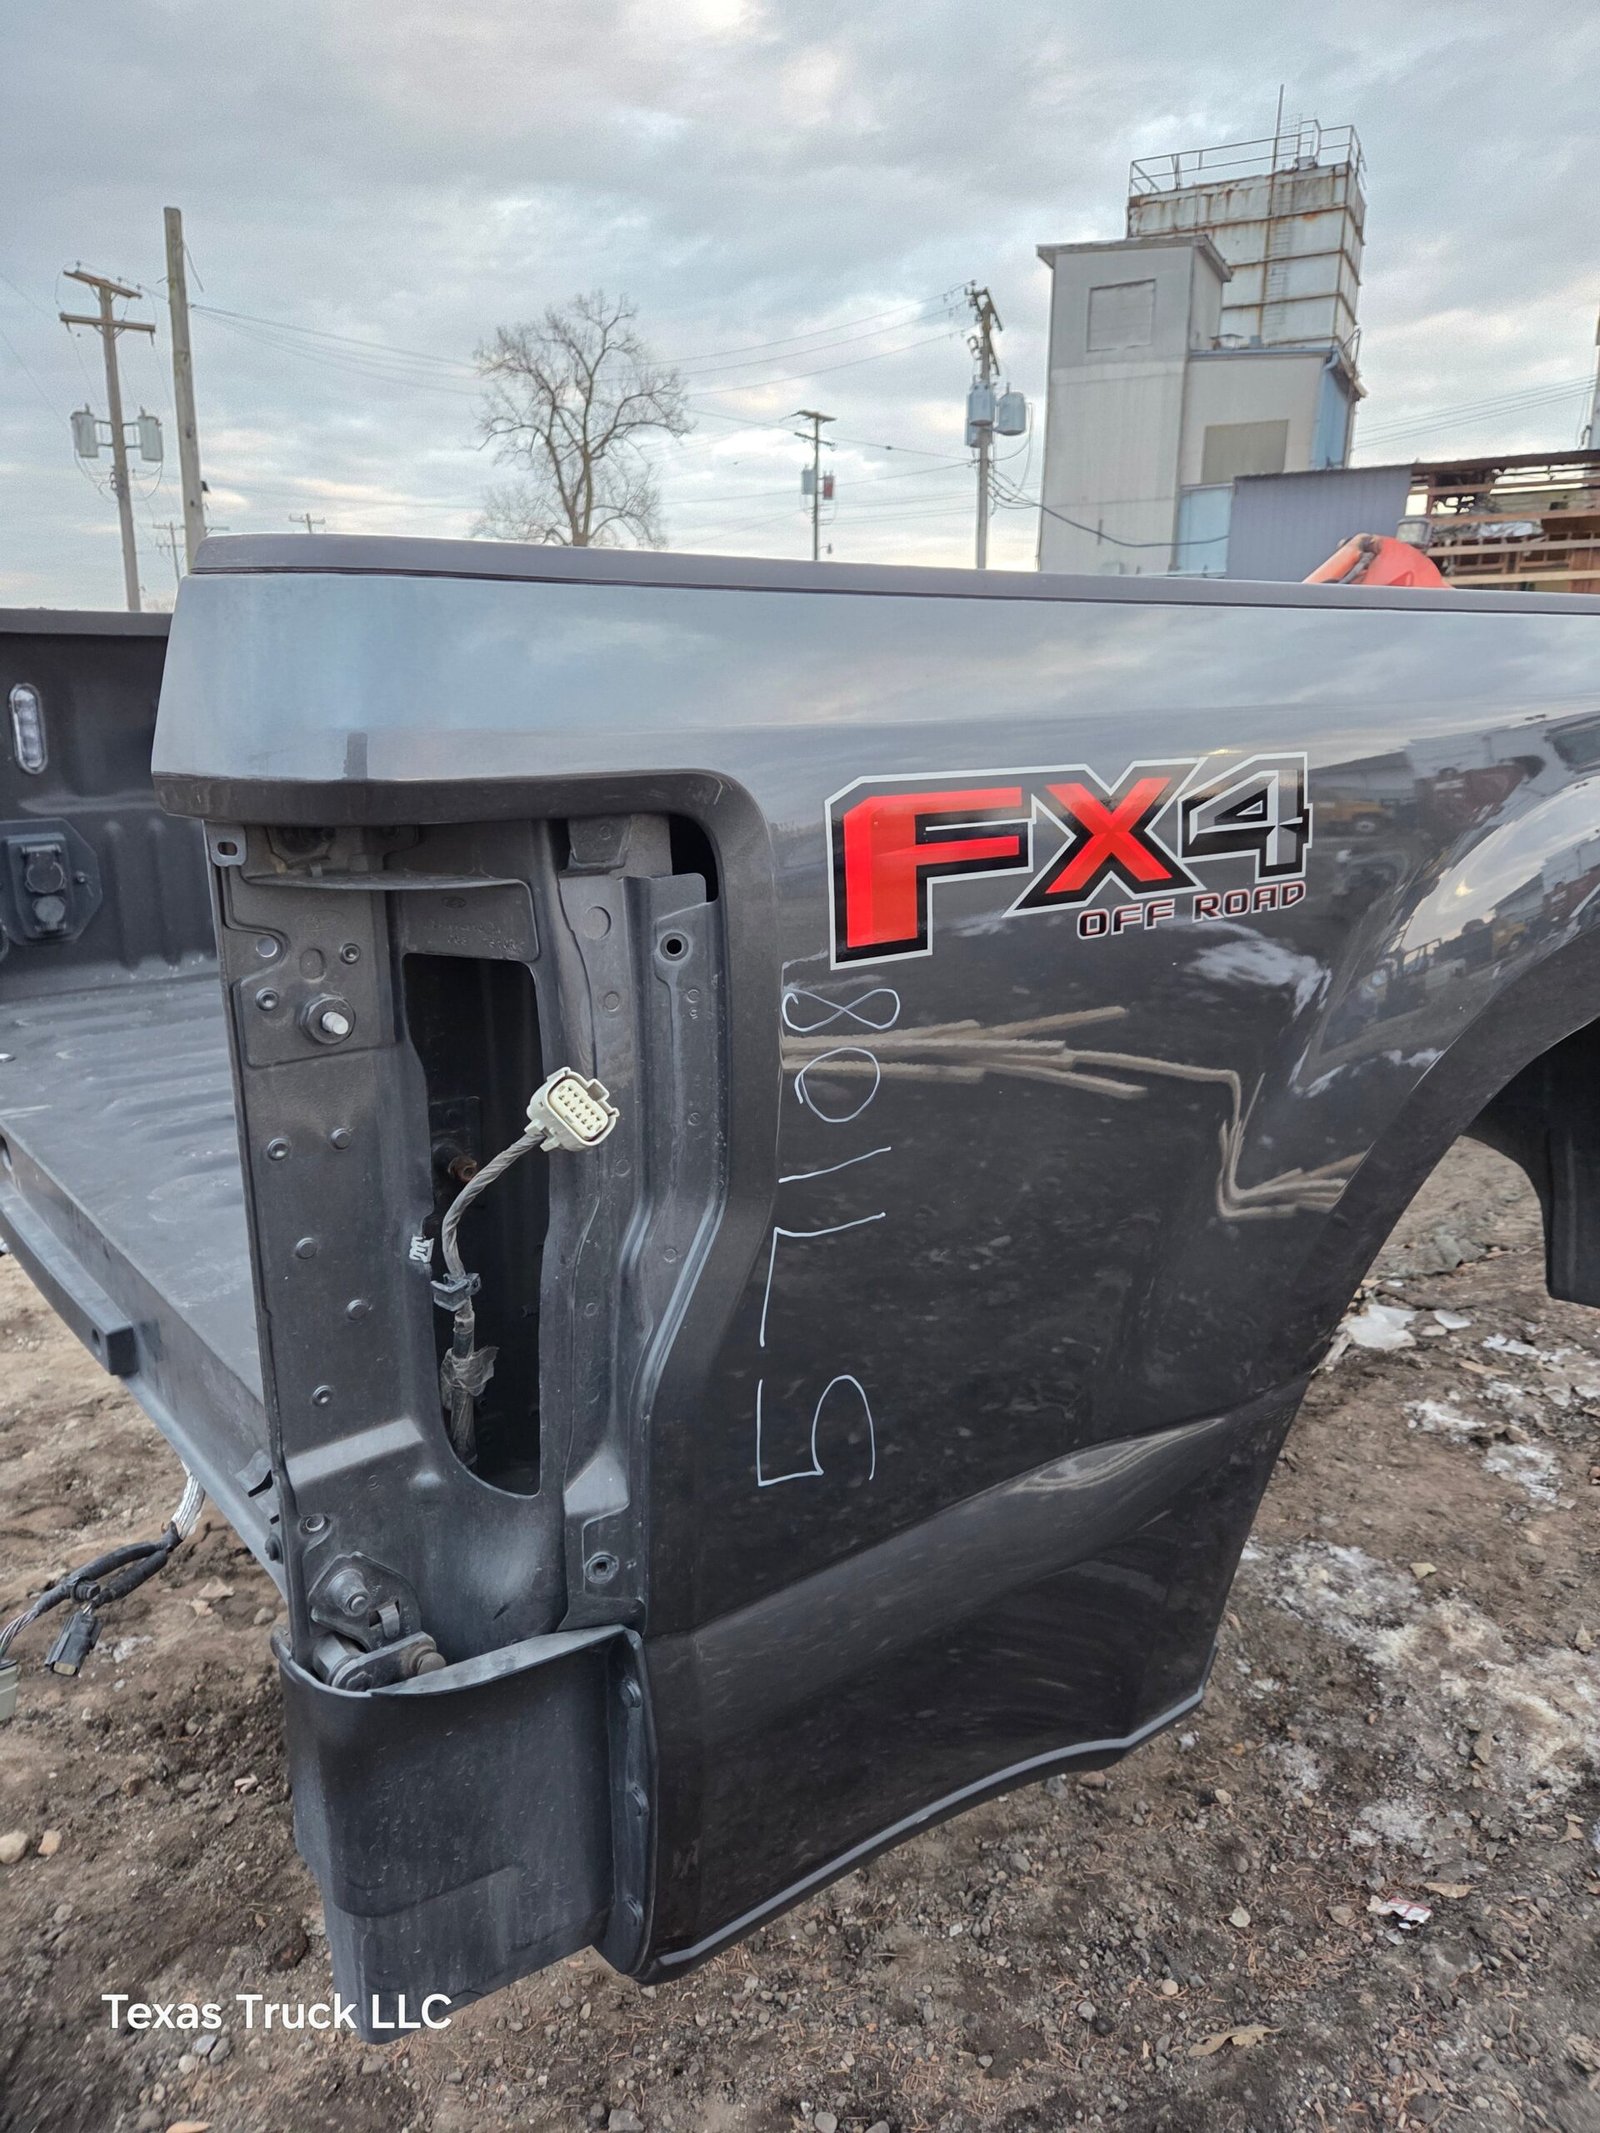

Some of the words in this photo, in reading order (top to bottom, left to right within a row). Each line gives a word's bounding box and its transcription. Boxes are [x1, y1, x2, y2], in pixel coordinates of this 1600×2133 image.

[825, 752, 1312, 970] FX4
[1077, 898, 1176, 940] OFF
[1192, 880, 1307, 923] ROAD
[757, 987, 901, 1487] 57108
